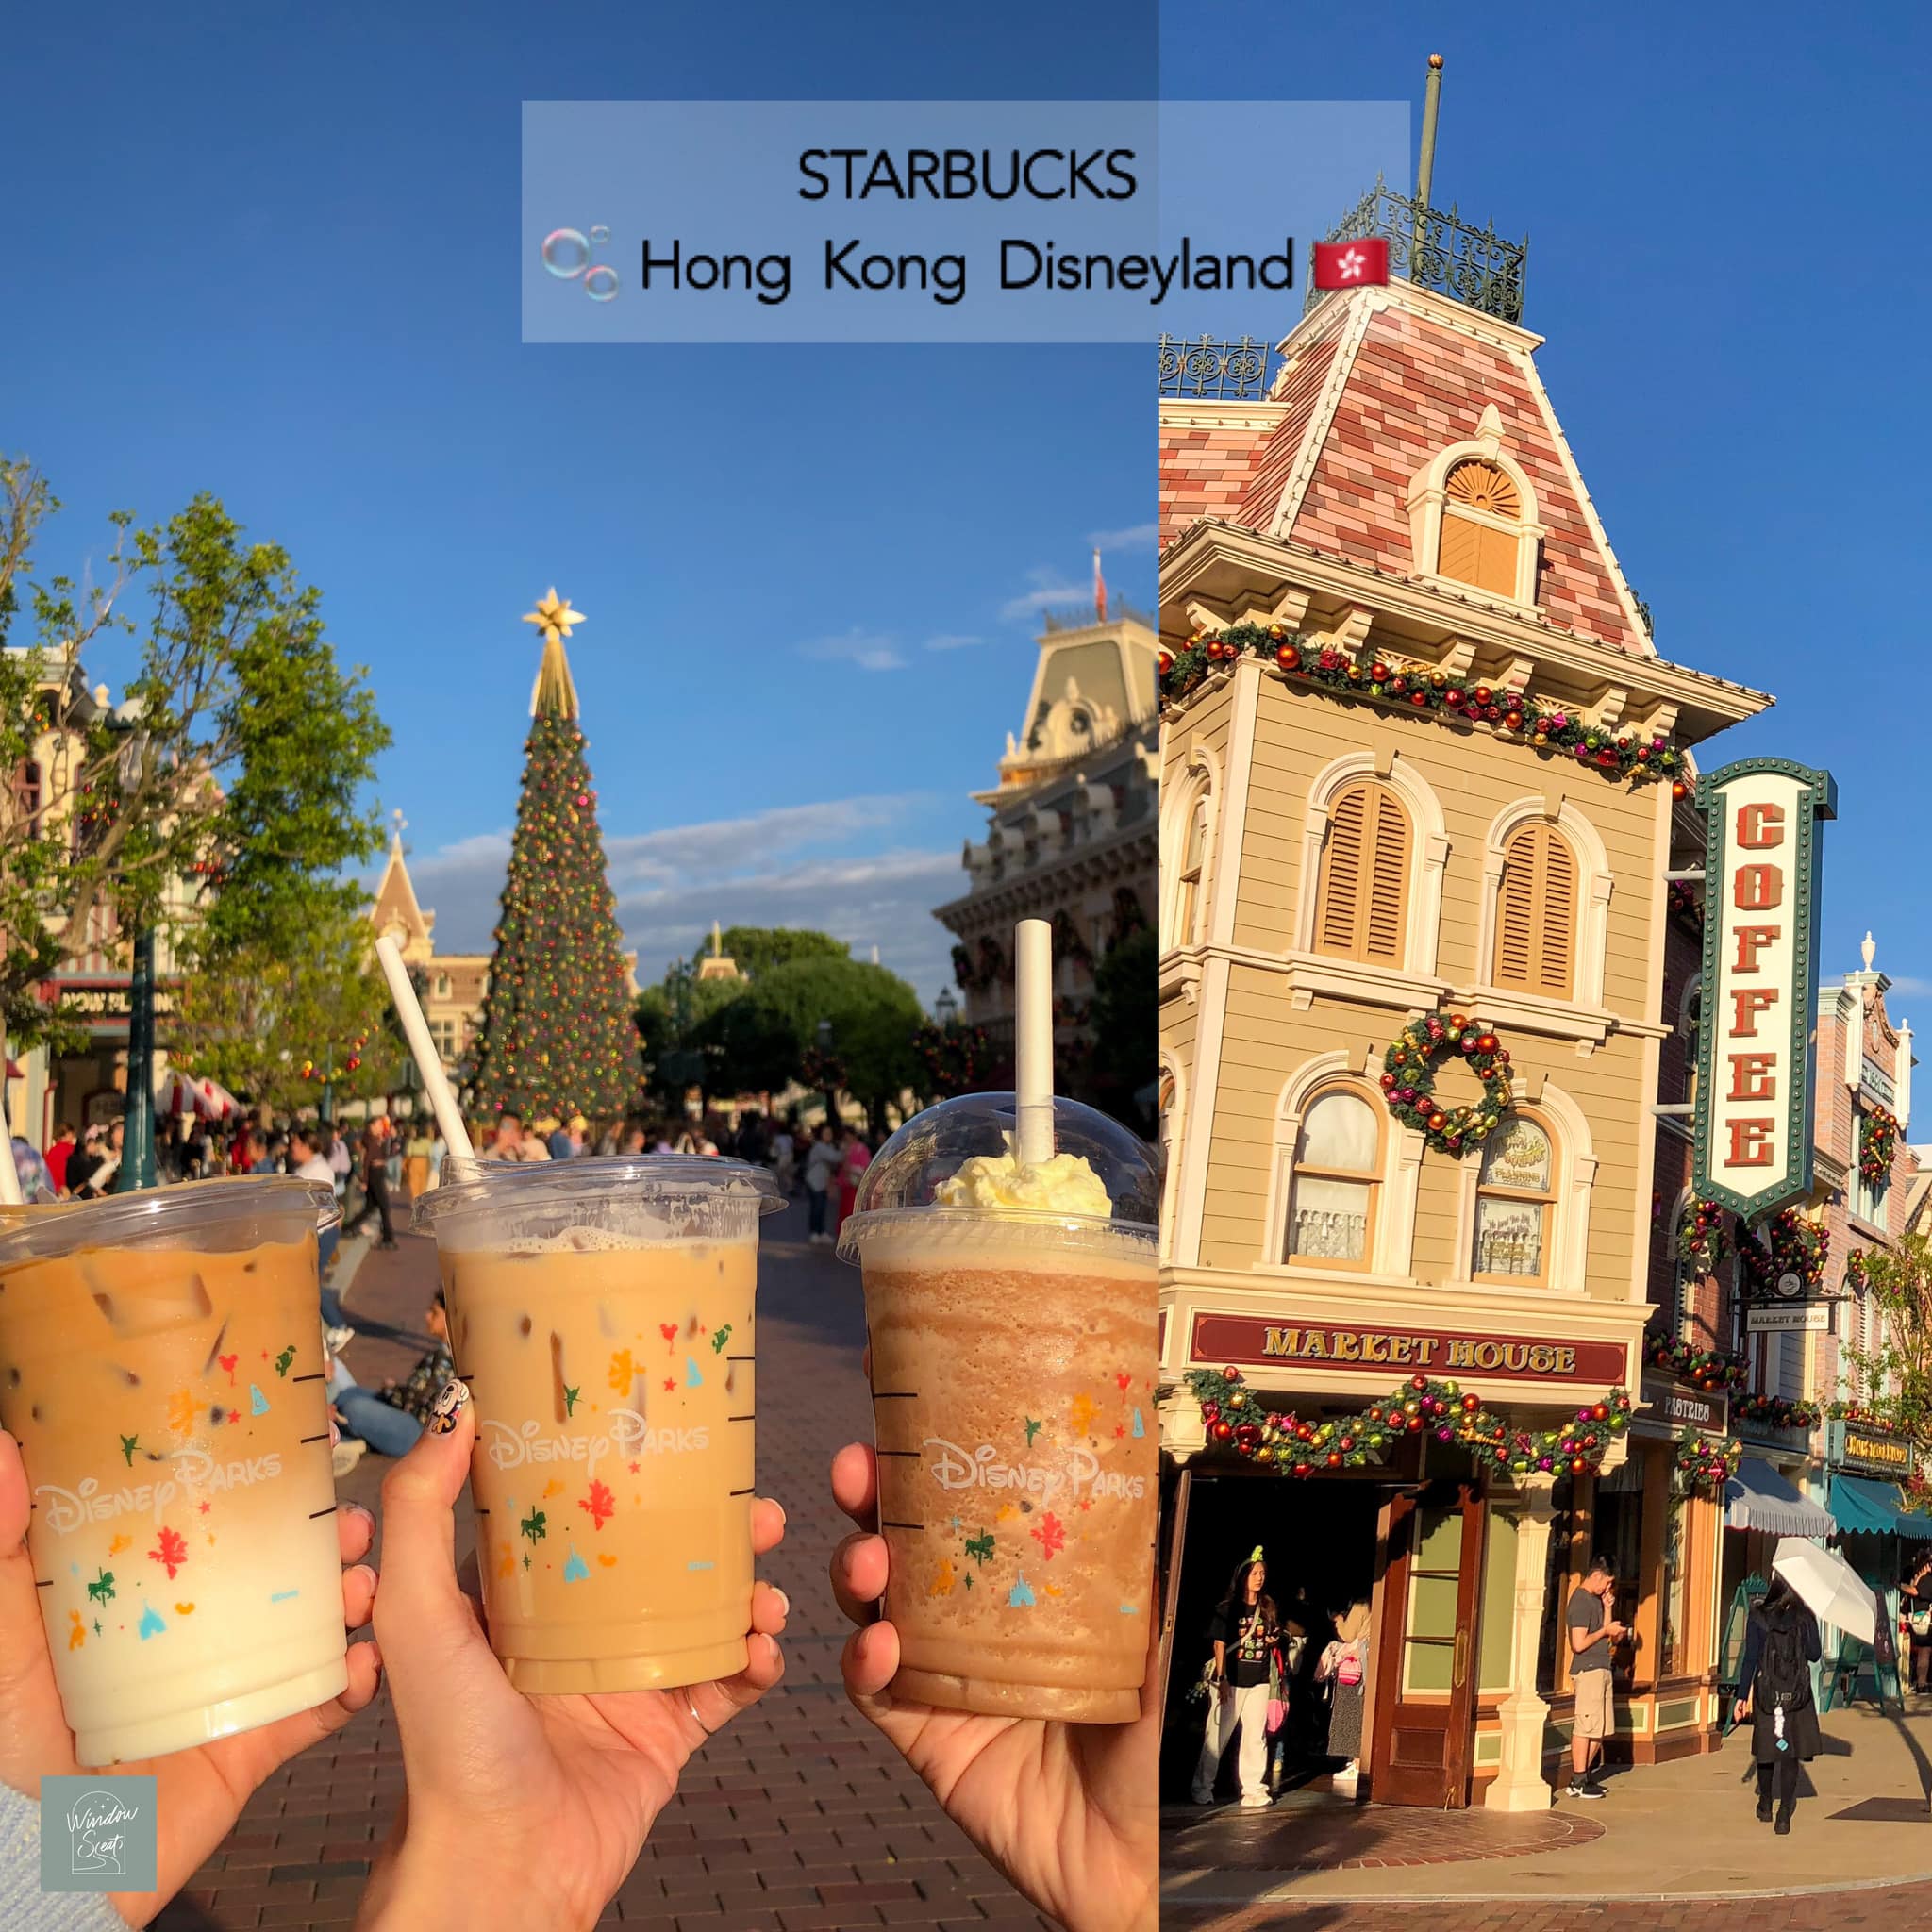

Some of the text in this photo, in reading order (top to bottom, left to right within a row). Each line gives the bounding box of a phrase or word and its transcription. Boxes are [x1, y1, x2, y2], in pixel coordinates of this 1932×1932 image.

[1724, 802, 1785, 1168] COFFEE
[62, 991, 107, 1013] NOW
[1750, 1314, 1826, 1324] MARKET HOUSE
[1261, 1326, 1576, 1374] MARKET HOUSE
[1664, 1396, 1710, 1422] PASTRIES
